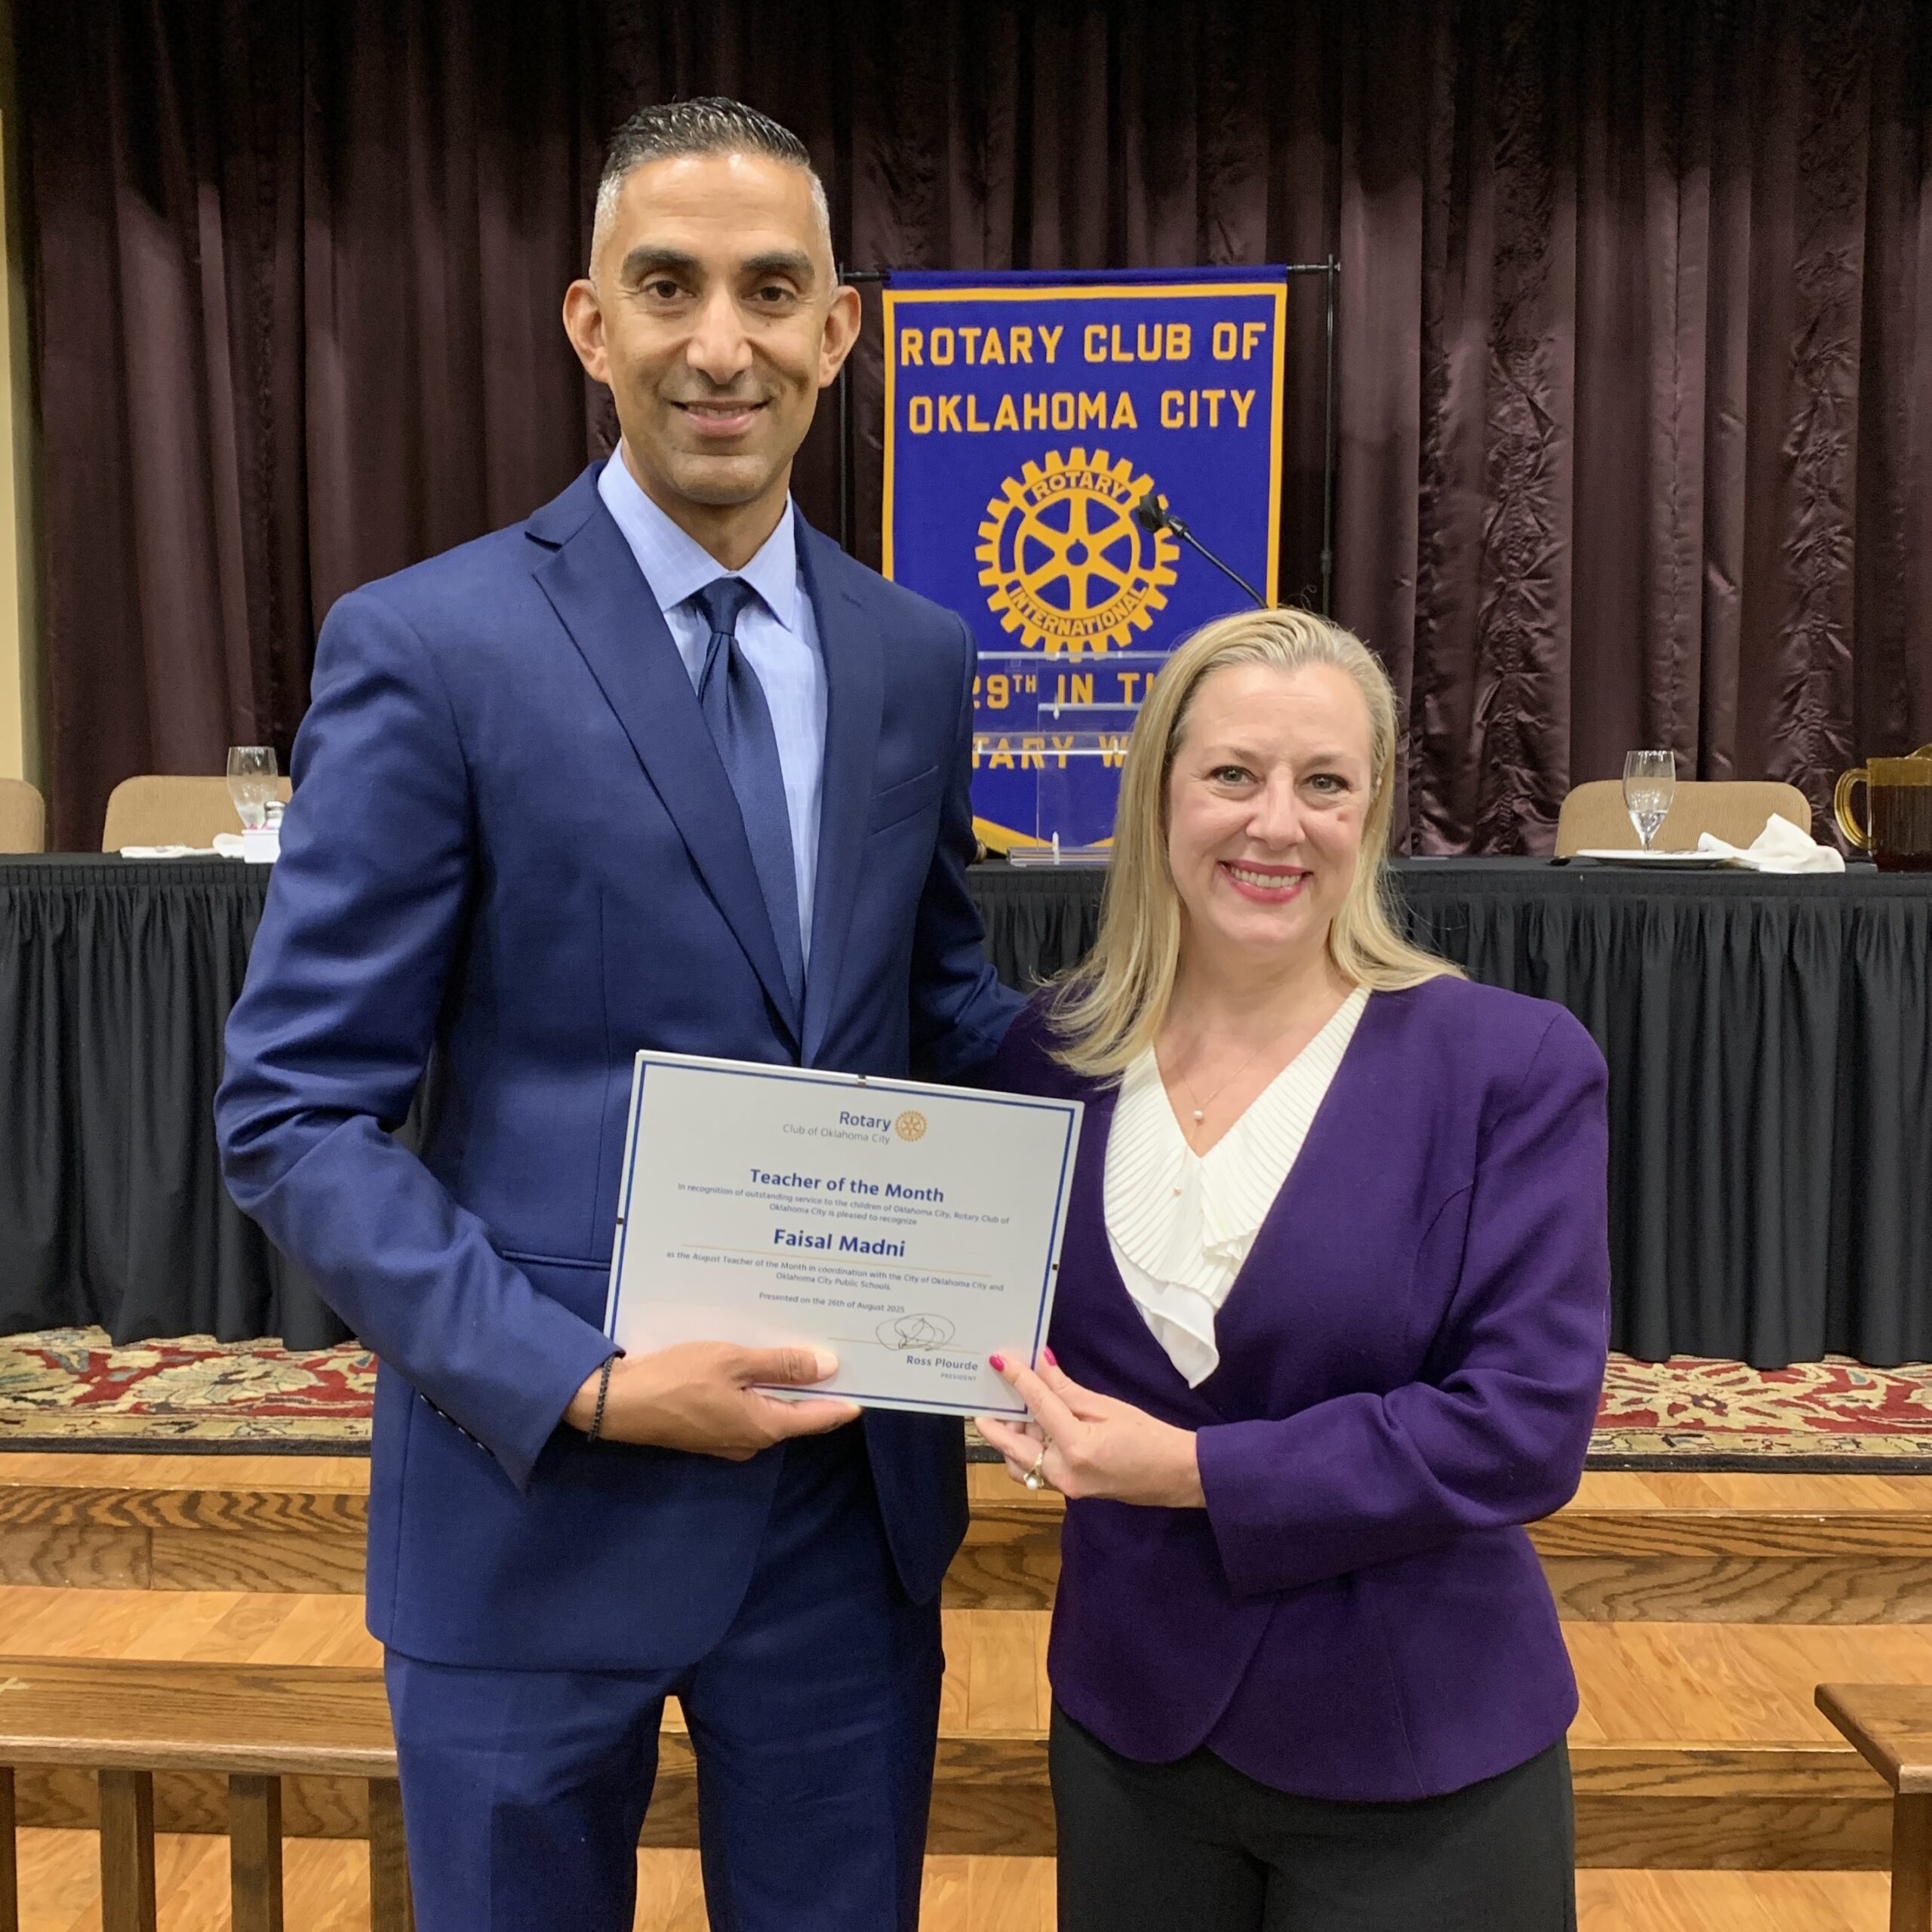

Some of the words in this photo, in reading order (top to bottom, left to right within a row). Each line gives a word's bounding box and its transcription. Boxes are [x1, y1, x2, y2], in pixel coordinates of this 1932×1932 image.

[900, 325, 1063, 366] ROTARY
[1084, 323, 1192, 363] CLUB
[1212, 321, 1266, 361] OF
[909, 391, 1137, 434] OKLAHOMA
[1160, 389, 1255, 429] CITY
[1031, 470, 1128, 502] ROTARY
[1008, 586, 1148, 636] INTERNATIONAL
[1057, 673, 1094, 706] IN
[783, 1124, 805, 1134] Club
[808, 1127, 818, 1136] of
[820, 1128, 869, 1141] Oklahoma
[871, 1134, 891, 1146] City
[839, 1111, 891, 1132] Rotary
[751, 1169, 821, 1189] Teacher
[826, 1177, 846, 1192] of
[850, 1180, 879, 1195] the
[884, 1183, 943, 1202] Month
[688, 1185, 734, 1195] recognition
[745, 1191, 793, 1203] outstanding
[795, 1196, 823, 1204] service
[850, 1201, 881, 1211] children
[893, 1204, 933, 1217] Oklahoma
[954, 1211, 980, 1222] Rotary
[981, 1214, 999, 1223] Club
[769, 1203, 809, 1214] Oklahoma
[811, 1208, 826, 1217] City
[836, 1211, 867, 1220] pleased
[879, 1216, 917, 1225] recognize
[774, 1229, 832, 1250] Faisal
[838, 1235, 905, 1257] Madni
[692, 1253, 721, 1263] August
[724, 1256, 753, 1266] Teacher
[766, 1260, 779, 1269] the
[780, 1262, 807, 1271] Month
[817, 1267, 868, 1277] coordination
[903, 1274, 919, 1283] City
[931, 1277, 970, 1287] Oklahoma
[971, 1281, 987, 1291] City
[776, 1272, 815, 1283] Oklahoma
[817, 1276, 832, 1285] City
[835, 1278, 857, 1287] Public
[759, 1292, 798, 1303] Presented
[857, 1302, 884, 1312] August
[886, 1305, 905, 1313] 2025
[906, 1355, 931, 1366] Ross
[935, 1358, 978, 1371] Plourde
[940, 1373, 976, 1381] PRESIDENT
